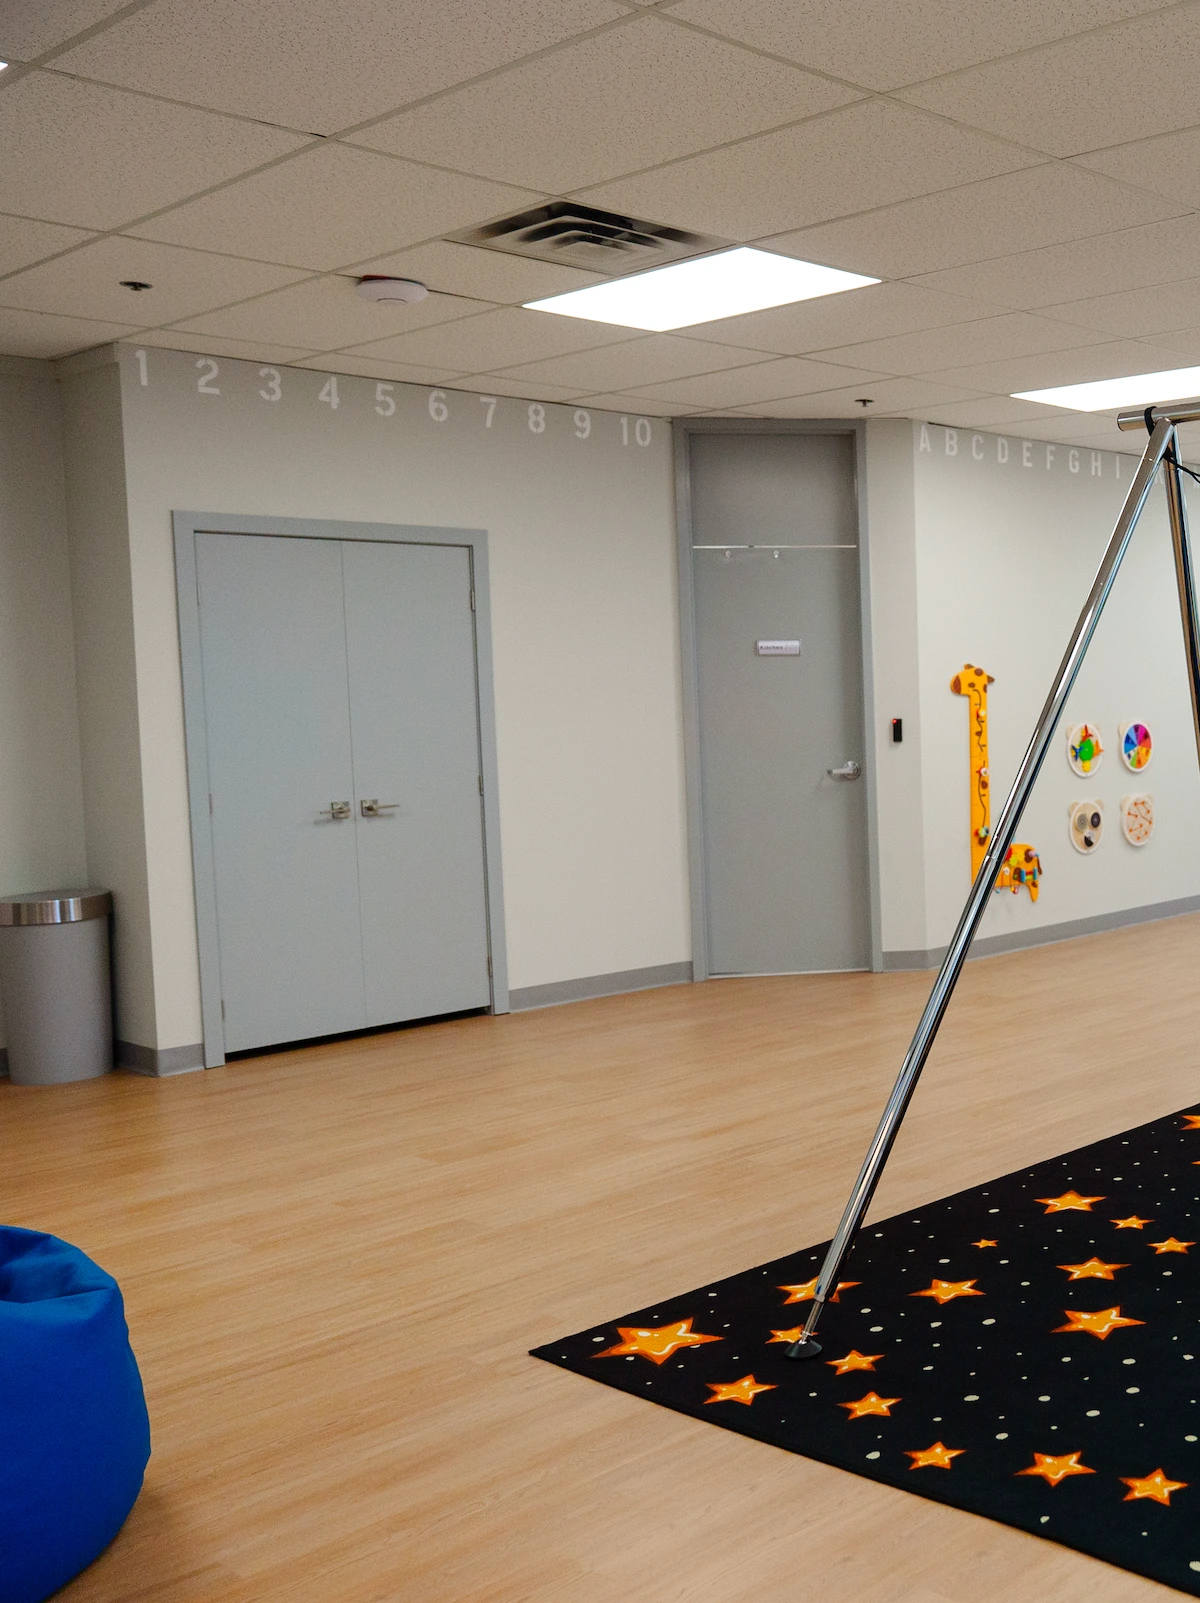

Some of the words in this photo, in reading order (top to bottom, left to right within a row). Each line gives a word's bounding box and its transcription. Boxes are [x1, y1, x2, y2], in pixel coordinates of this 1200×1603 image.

[135, 350, 148, 386] 1
[195, 358, 220, 394] 2
[259, 367, 282, 401] 3
[318, 376, 340, 409] 4
[374, 383, 396, 416] 5
[428, 391, 448, 422] 6
[480, 397, 497, 428] 7
[528, 403, 546, 433] 8
[573, 409, 591, 439] 9
[620, 416, 652, 447] 10
[919, 424, 932, 453] A
[945, 429, 958, 456] B
[971, 434, 984, 461] C
[997, 438, 1009, 464] D
[1022, 442, 1033, 468] E
[1046, 446, 1056, 470] F
[1068, 450, 1080, 474] G
[1091, 452, 1102, 477] H
[1115, 455, 1121, 479] I
